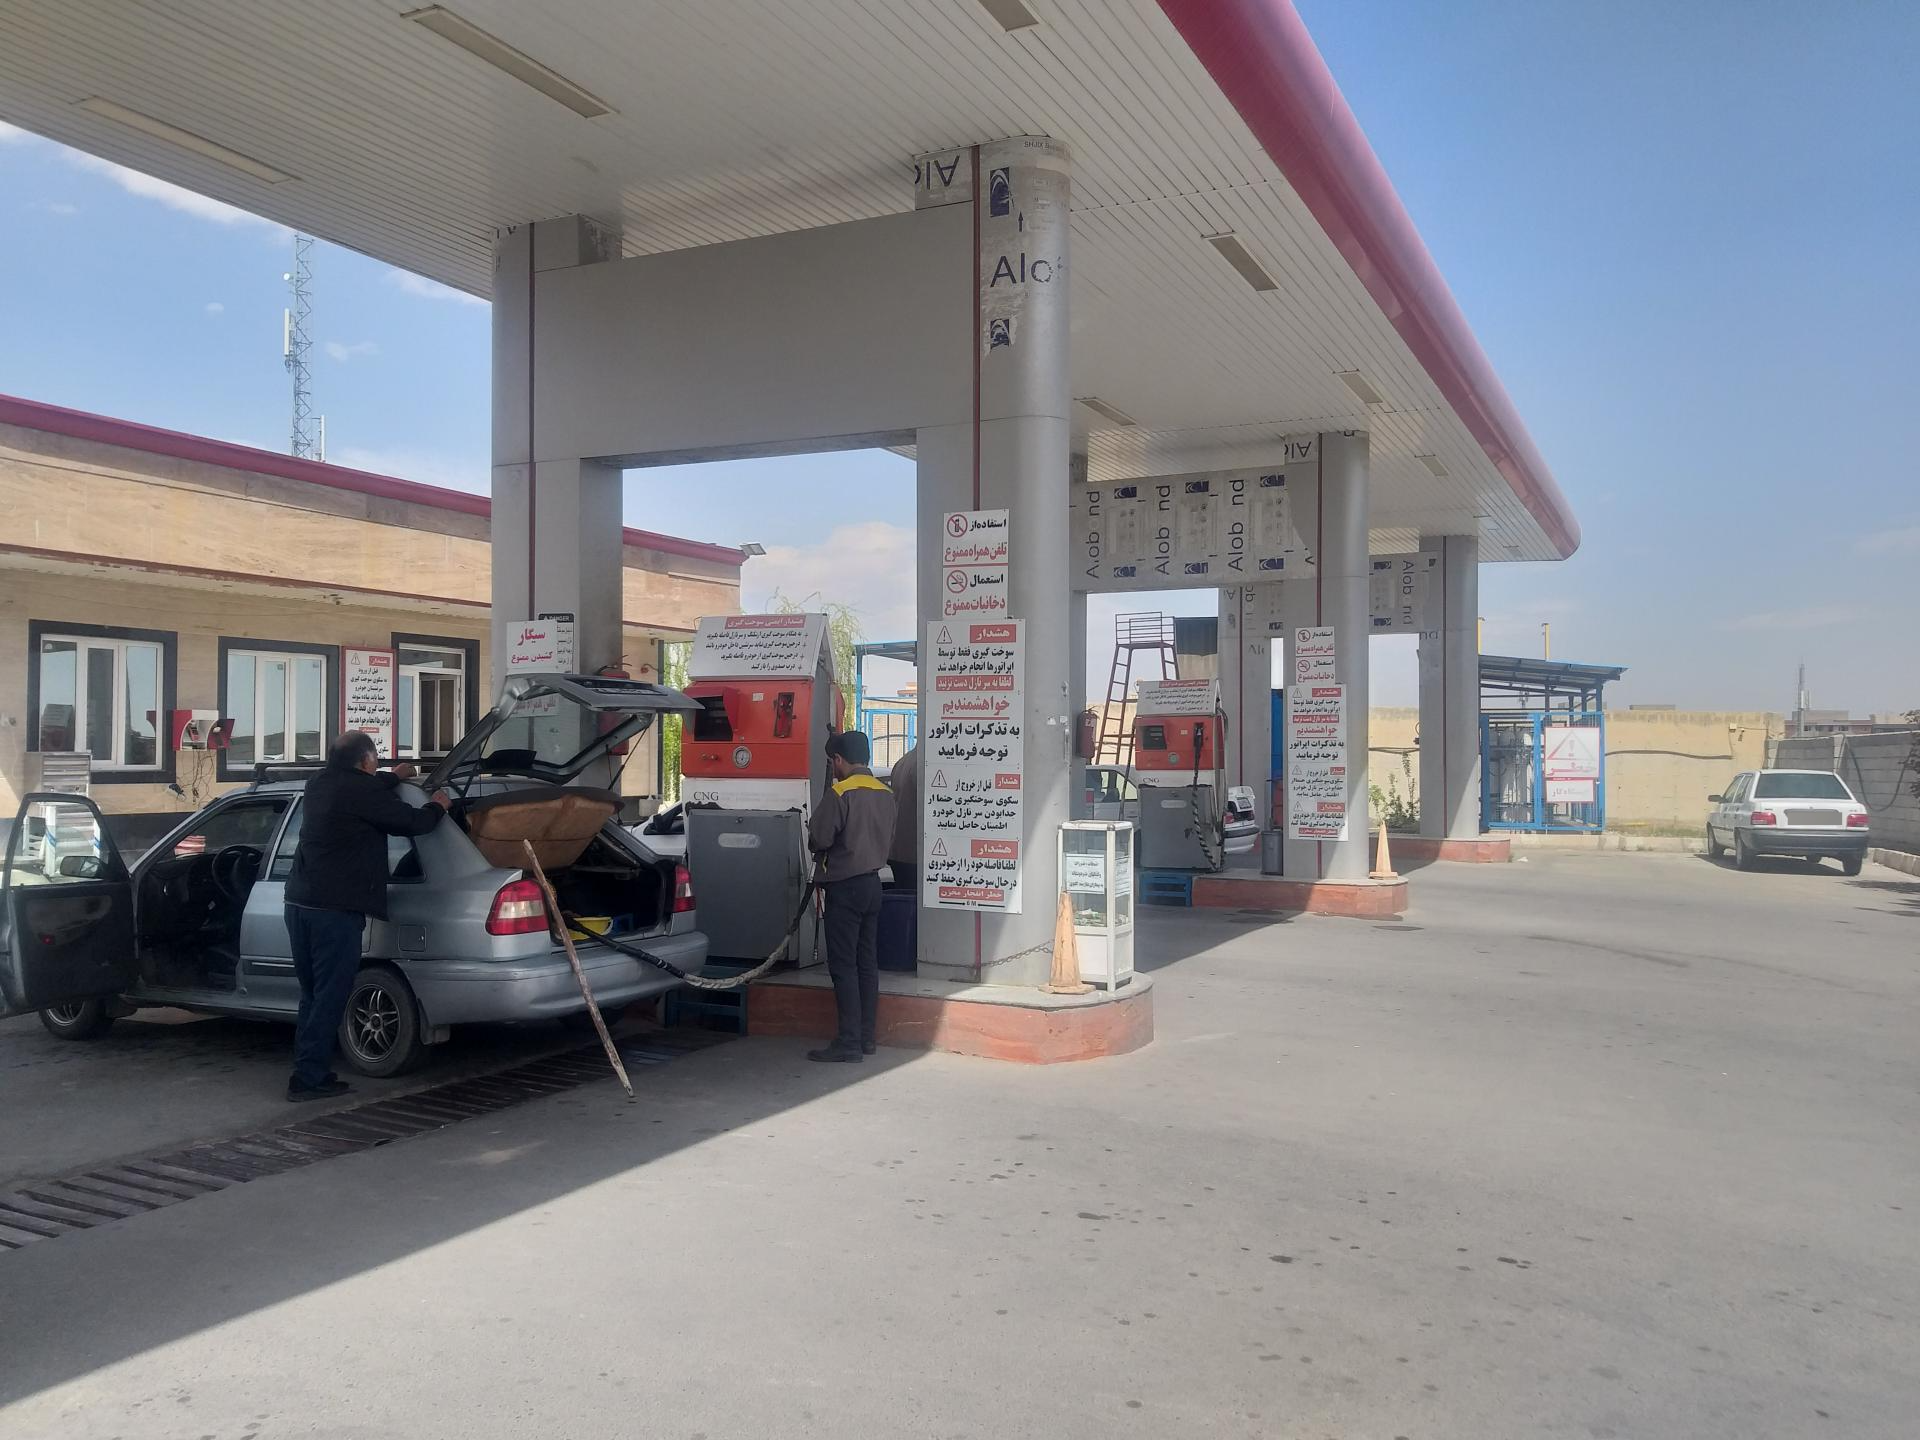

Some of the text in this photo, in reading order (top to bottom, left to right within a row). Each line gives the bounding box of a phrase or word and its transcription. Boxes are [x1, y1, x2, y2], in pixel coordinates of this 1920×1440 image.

[977, 517, 1007, 529] استفاده
[944, 542, 1007, 562] تلفن همراه ممنوع
[969, 573, 1004, 587] استعمال
[944, 595, 1006, 616] دخانیات ممنوع
[517, 628, 545, 646] سیگار
[975, 628, 1010, 641] هشدار
[530, 651, 554, 662] کشیدن
[937, 646, 1014, 660] سوخت گیری فقط توسط
[511, 655, 529, 664] ممنوع
[937, 662, 947, 672] شد
[947, 661, 968, 674] خواهد
[968, 661, 986, 674] انجام
[953, 678, 968, 688] دست
[942, 695, 1010, 716] خواهشمندیم
[928, 722, 1020, 740] به تذکرات اپراتور
[938, 743, 1009, 762] توجه فرمایید
[960, 779, 976, 792] خروج
[976, 779, 982, 792] از
[982, 780, 992, 792] قبل
[997, 776, 1018, 787] هشدار
[693, 791, 719, 801] CNG
[936, 793, 953, 803] حتما
[996, 795, 1019, 807] سکوی
[932, 807, 955, 818] خودرو
[956, 807, 972, 819] نازل
[973, 811, 983, 819] سر
[937, 820, 1008, 832] اطمینان حاصل نمایید
[977, 843, 1012, 855] هشدار
[928, 857, 1017, 872] لطفا فاصله خود را از خودروی
[926, 872, 1017, 890] در حال سوخت گیری حفظ کنید
[940, 888, 1002, 899] خطر انفجار مخزن
